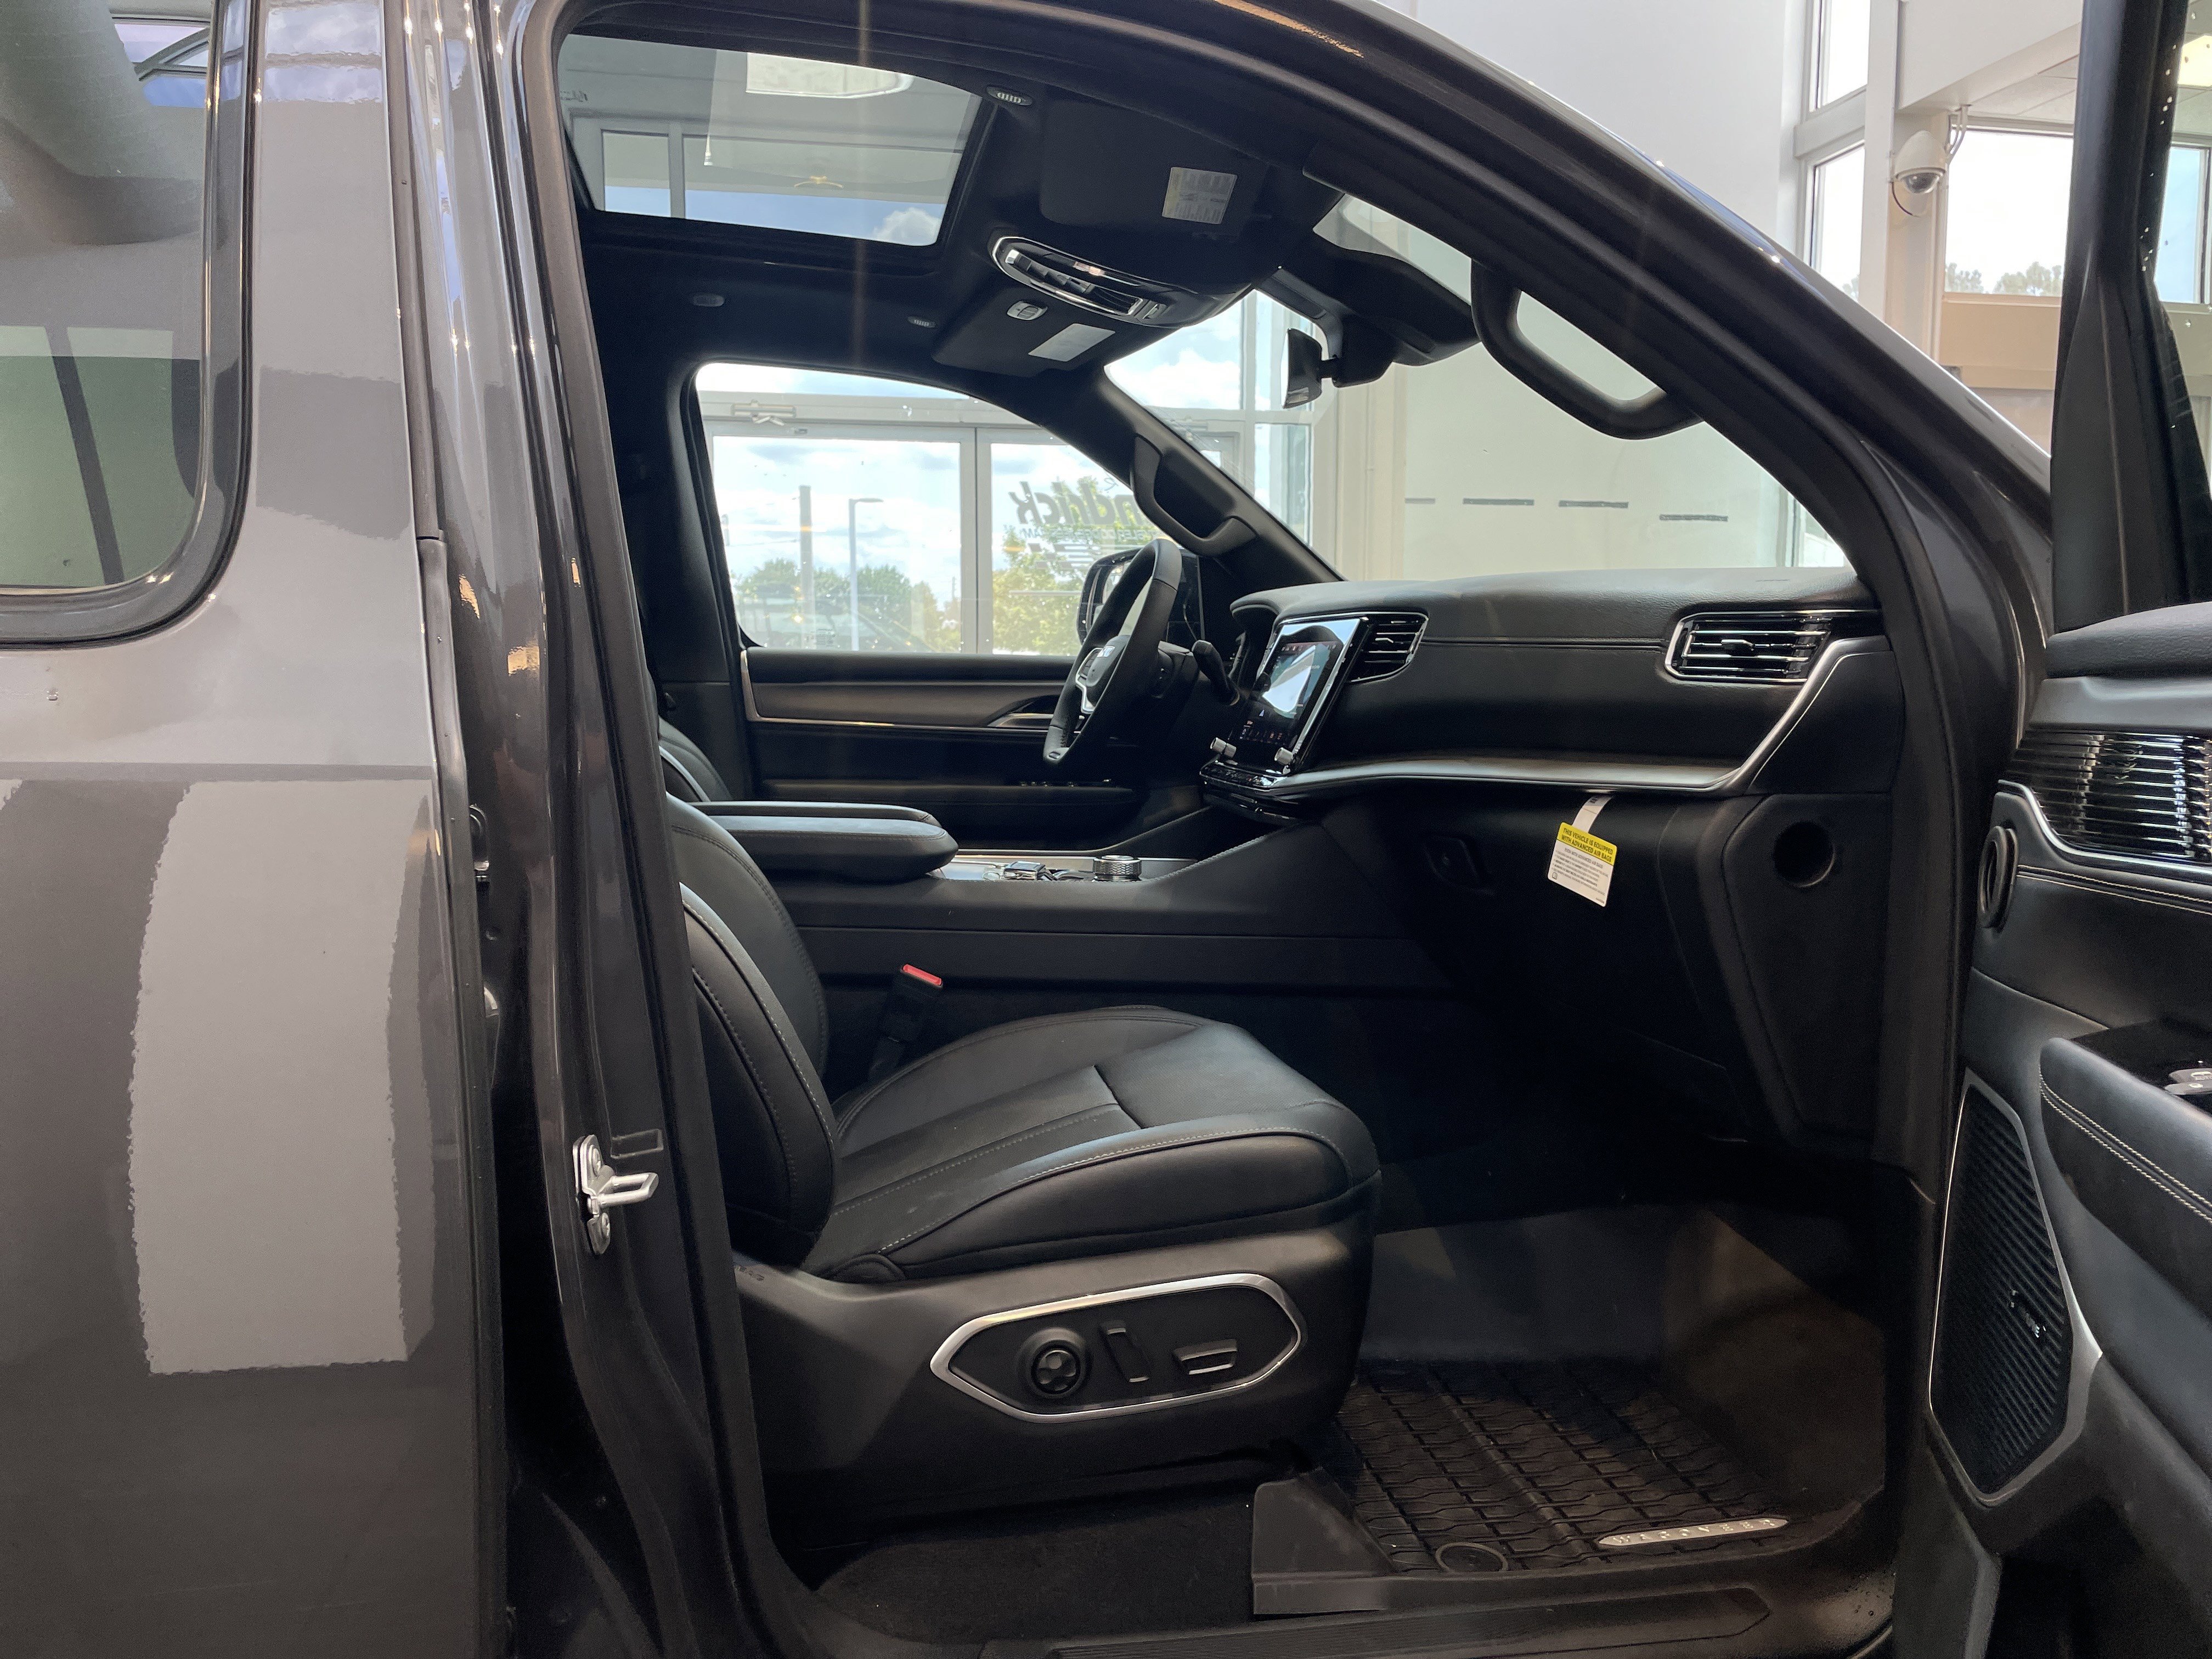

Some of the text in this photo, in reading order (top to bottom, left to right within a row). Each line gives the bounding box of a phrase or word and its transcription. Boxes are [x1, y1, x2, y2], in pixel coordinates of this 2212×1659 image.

[1561, 834, 1572, 843] WITH
[1572, 839, 1594, 853] ADVANCED
[1601, 852, 1612, 862] BAGS
[1564, 827, 1572, 836] THIS
[1572, 831, 1589, 844] VEHICLE
[1594, 841, 1613, 855] EQUIPPED
[1613, 1518, 1776, 1544] WAGONEER
